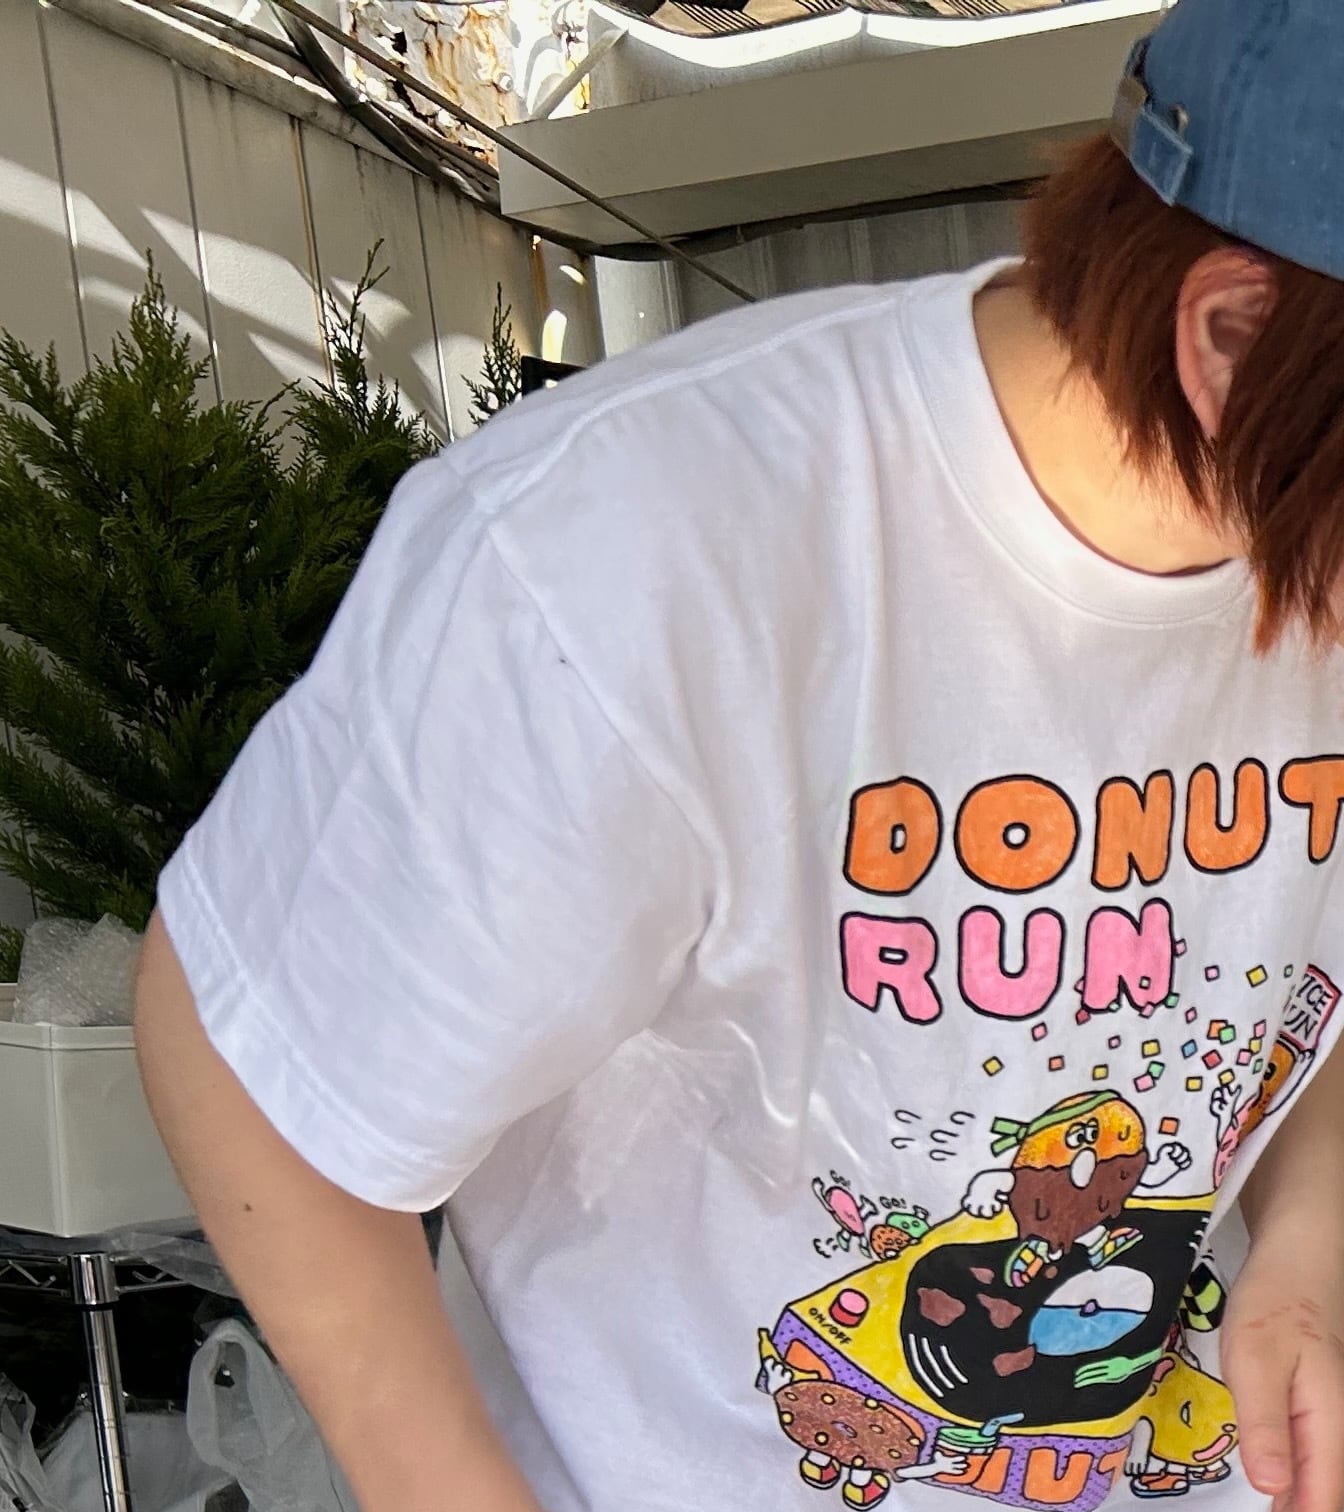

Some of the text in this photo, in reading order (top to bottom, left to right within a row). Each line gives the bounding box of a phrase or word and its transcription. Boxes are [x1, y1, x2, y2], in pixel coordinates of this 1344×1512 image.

[840, 898, 1175, 1025] RUN
[1296, 973, 1333, 1016] ICE
[1283, 1004, 1318, 1041] UN
